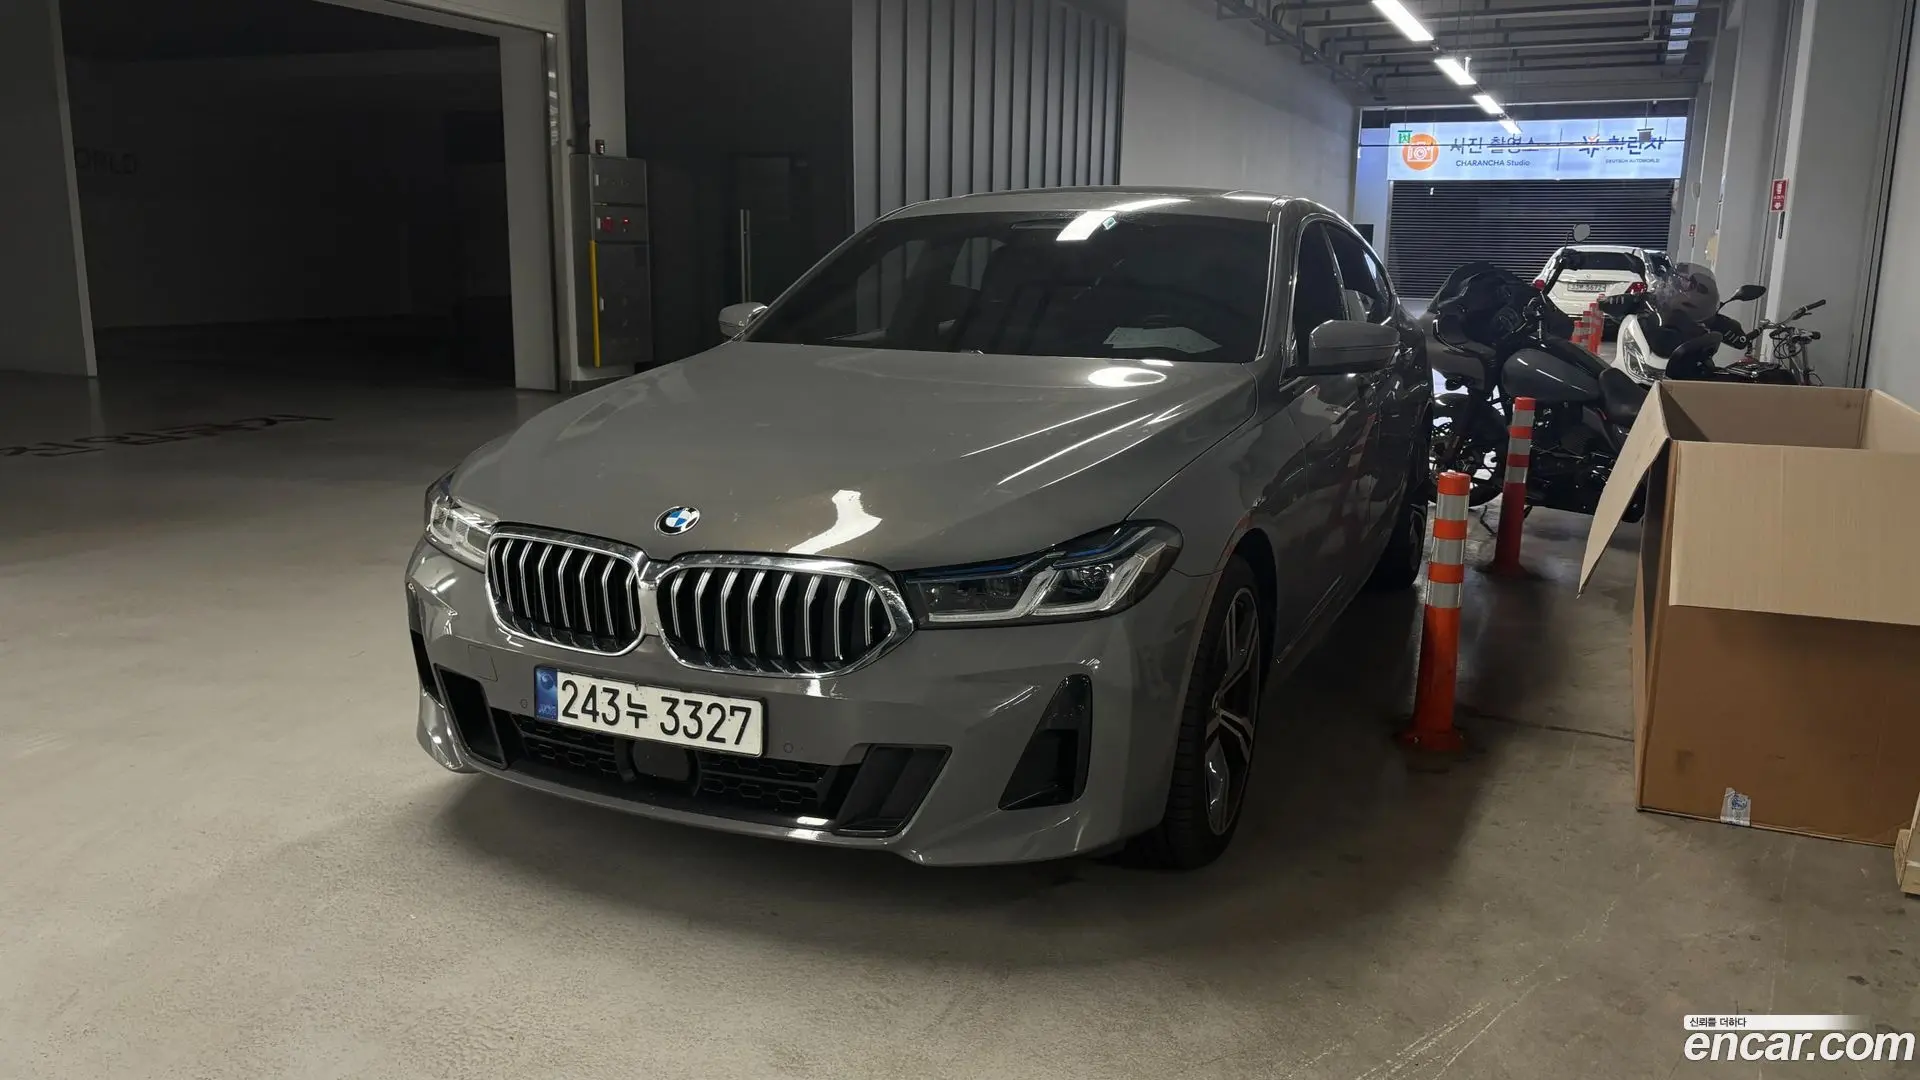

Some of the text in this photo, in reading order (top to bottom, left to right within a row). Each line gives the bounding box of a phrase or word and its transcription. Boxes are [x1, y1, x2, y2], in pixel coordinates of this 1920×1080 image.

[1449, 136, 1483, 155] 사진
[1455, 159, 1531, 167] CHARANCHA Studio
[561, 679, 751, 745] 243누 3327
